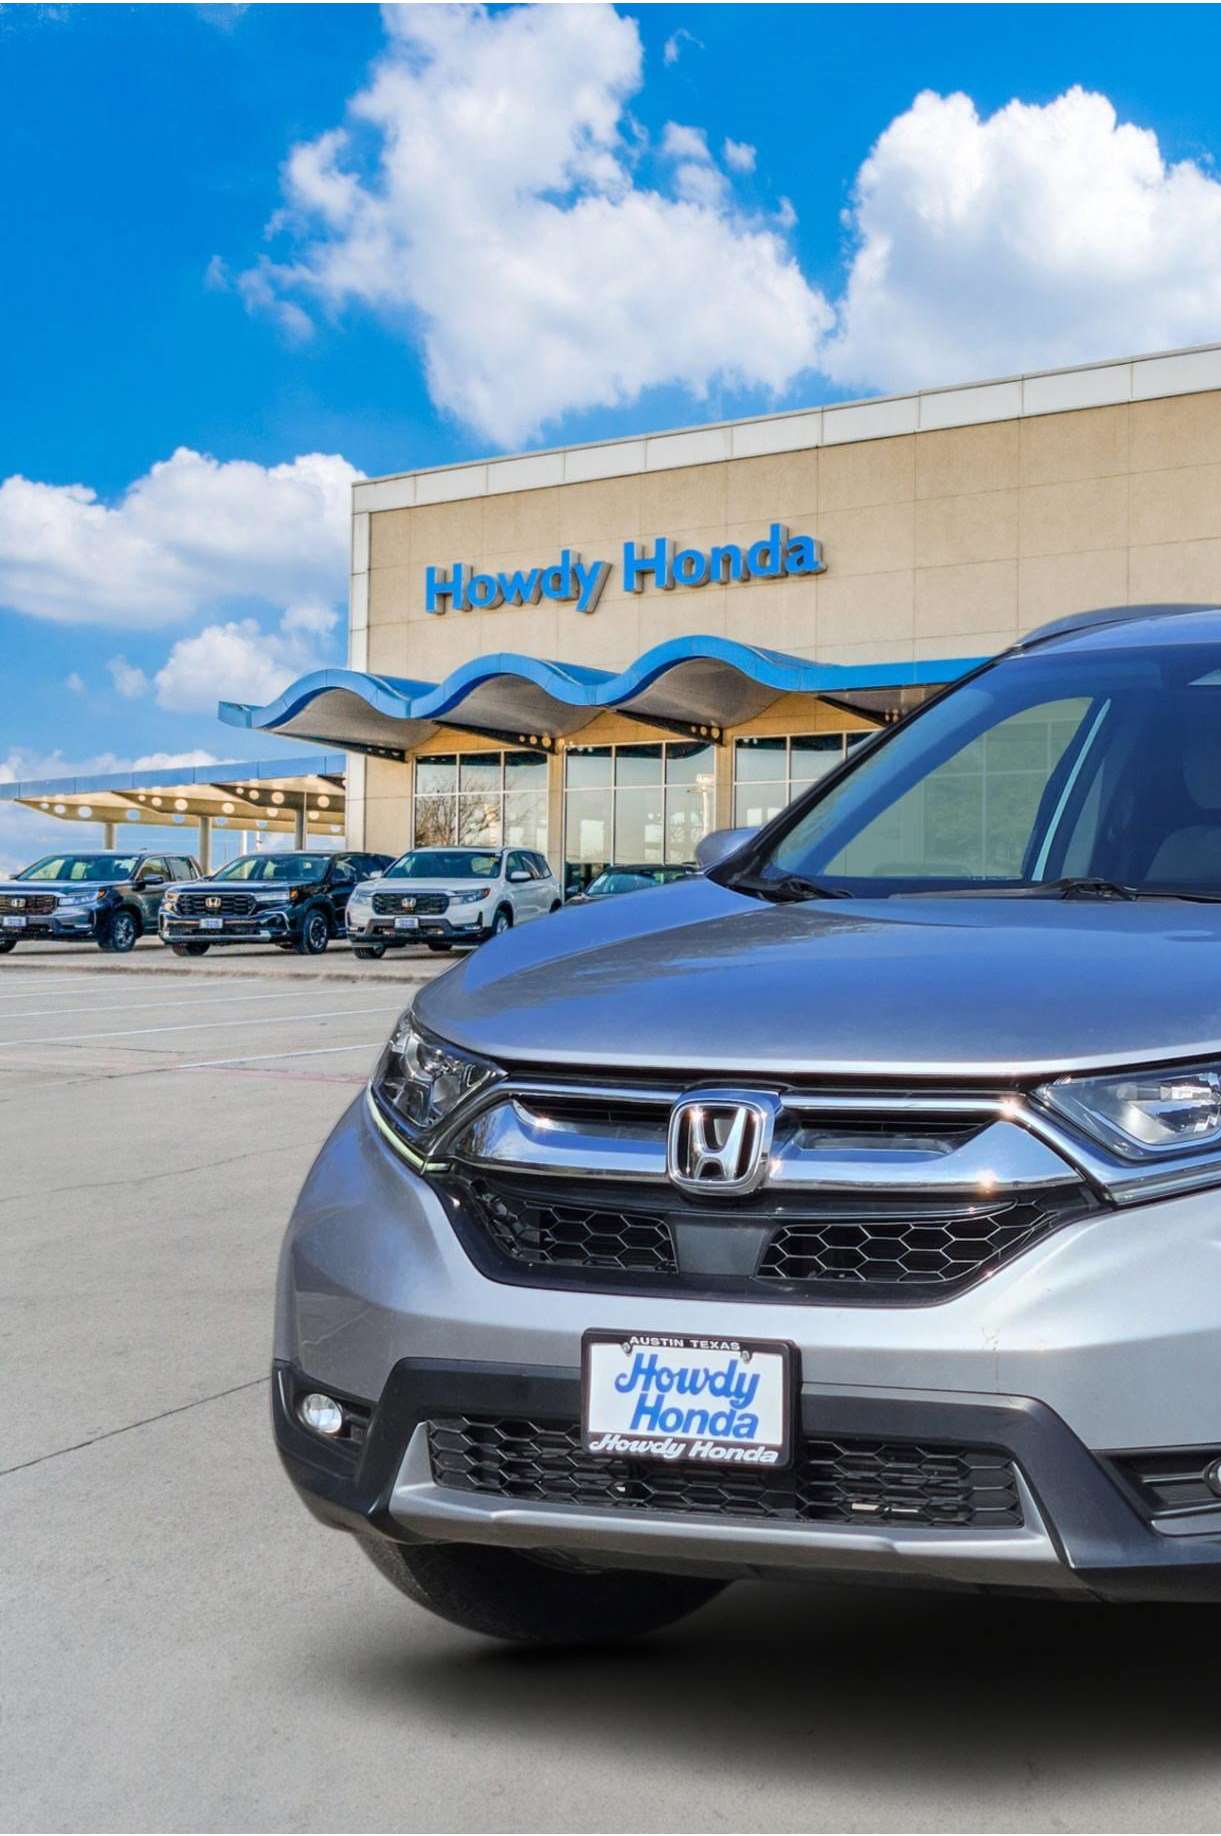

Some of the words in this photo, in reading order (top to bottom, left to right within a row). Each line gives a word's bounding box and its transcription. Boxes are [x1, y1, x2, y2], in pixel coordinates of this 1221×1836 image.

[425, 549, 612, 615] Howdy
[623, 523, 827, 594] Honda
[629, 1336, 684, 1347] AUSTIN
[690, 1339, 741, 1351] TEXAS
[614, 1353, 760, 1410] Howdy
[629, 1393, 759, 1440] Honda
[588, 1433, 686, 1459] Howdy
[688, 1441, 779, 1464] Honda
